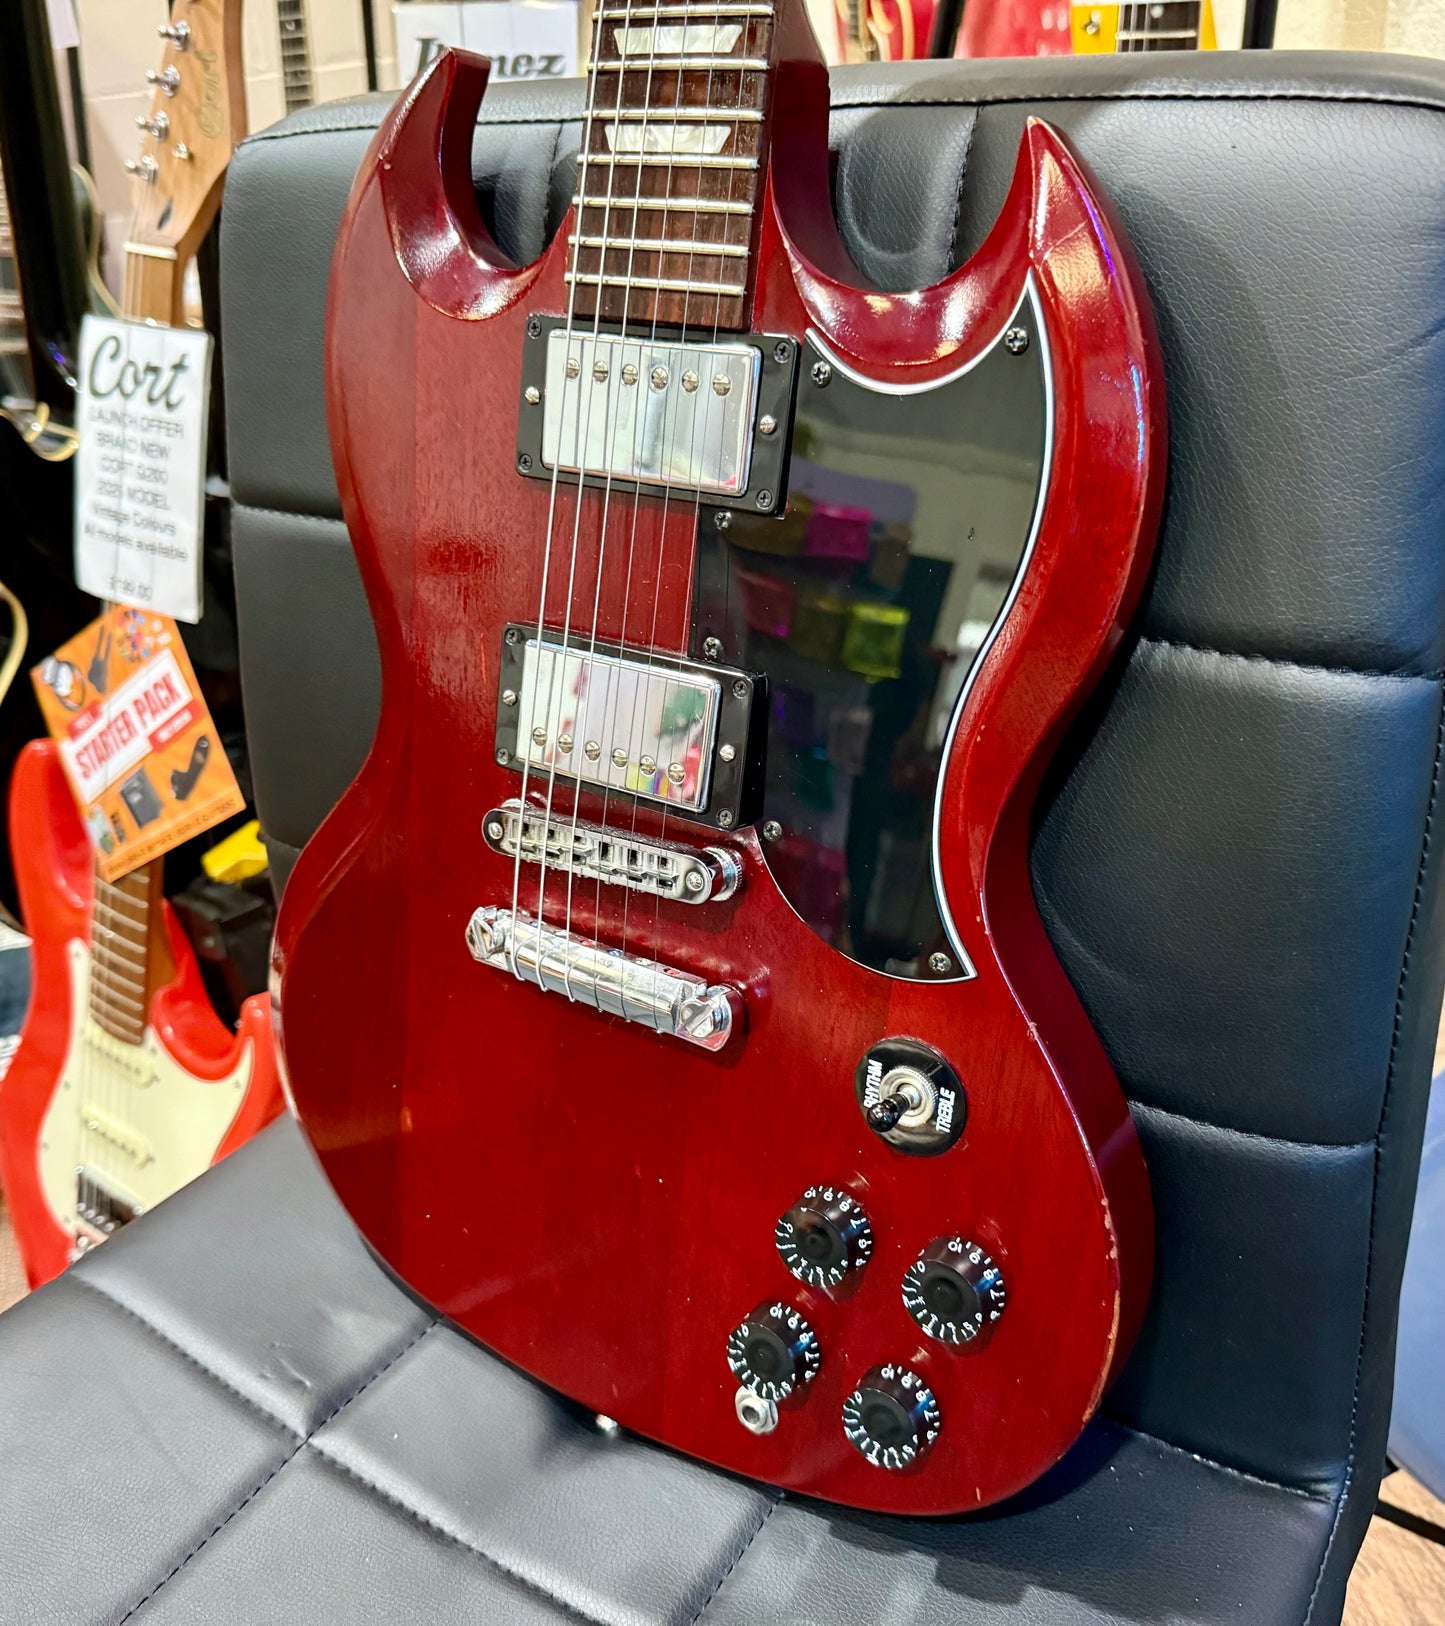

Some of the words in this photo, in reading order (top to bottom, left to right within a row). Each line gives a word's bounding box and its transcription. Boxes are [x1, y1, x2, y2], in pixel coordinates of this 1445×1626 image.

[89, 335, 189, 411] Cort
[140, 416, 184, 439] OFFER
[140, 440, 170, 459] NEW
[135, 541, 188, 562] available
[75, 710, 138, 780] STARTER
[133, 672, 182, 728] PACK
[935, 1086, 956, 1133] TREBLE
